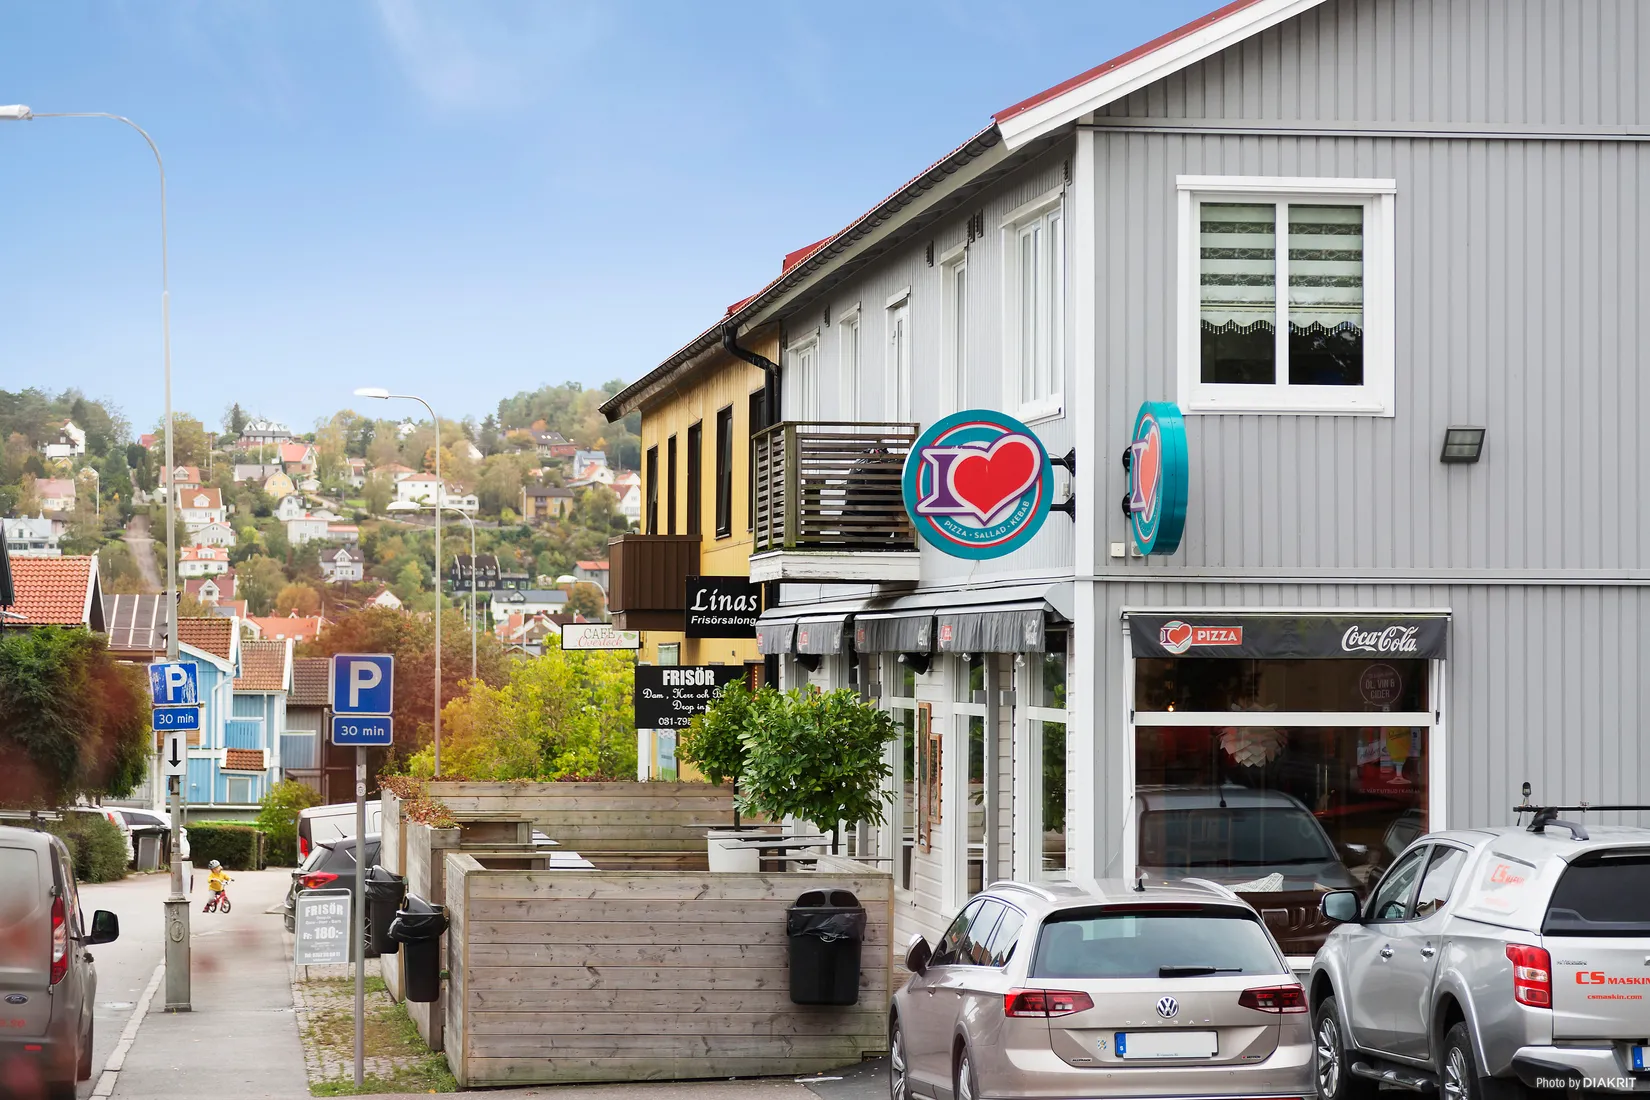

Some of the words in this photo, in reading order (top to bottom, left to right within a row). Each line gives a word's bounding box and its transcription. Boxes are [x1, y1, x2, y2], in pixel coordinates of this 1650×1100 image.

[944, 520, 967, 537] PIZZA
[974, 525, 1007, 539] SALLAD
[1010, 500, 1030, 526] KEBAB
[690, 588, 758, 612] Linas
[691, 615, 757, 627] Frisörsalong
[1197, 630, 1238, 641] PIZZA
[1341, 625, 1419, 652] Coca-Cola
[165, 665, 187, 701] P
[662, 667, 715, 686] FRISÖR
[349, 661, 382, 707] P
[642, 688, 664, 699] Dam
[672, 688, 694, 699] Herr
[696, 688, 710, 699] och
[672, 700, 695, 714] Drop
[159, 714, 173, 724] 30
[177, 713, 194, 724] min
[341, 726, 357, 736] 30
[363, 726, 384, 736] min
[305, 902, 344, 917] FRISÖR
[1575, 971, 1606, 985] CS
